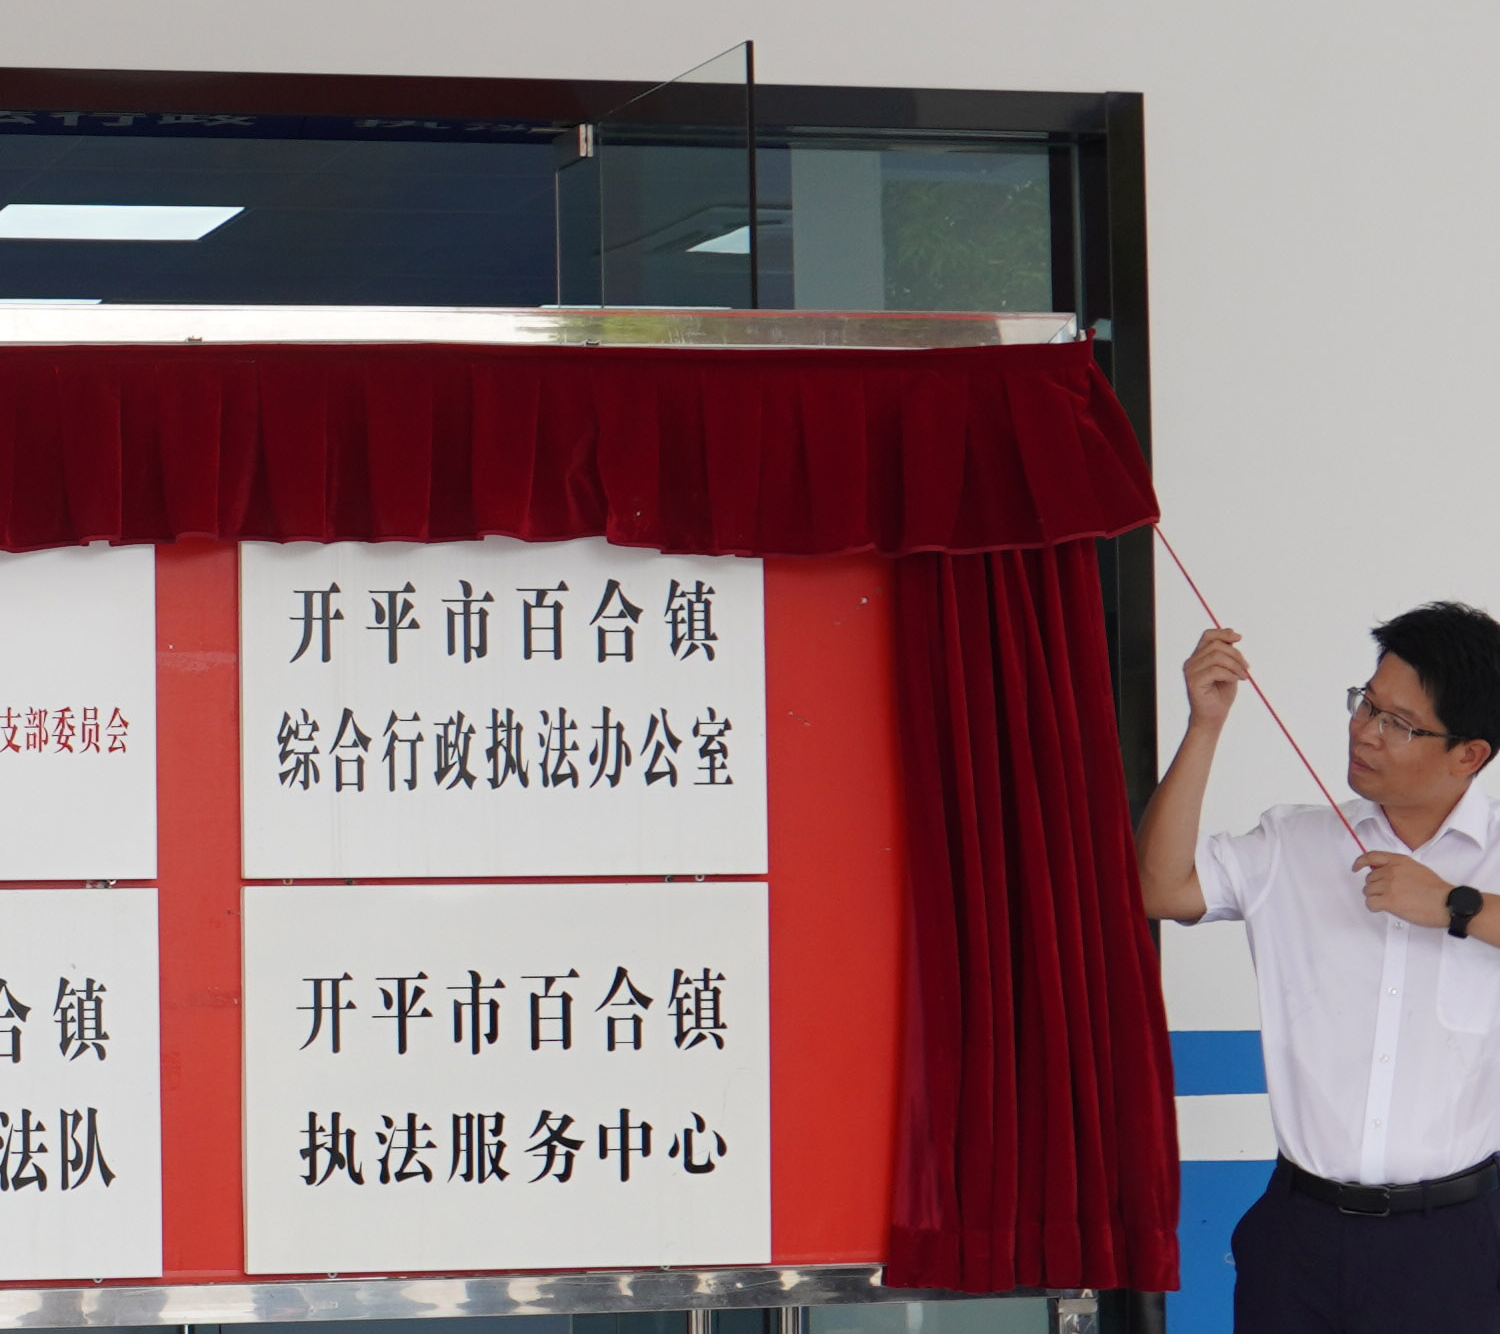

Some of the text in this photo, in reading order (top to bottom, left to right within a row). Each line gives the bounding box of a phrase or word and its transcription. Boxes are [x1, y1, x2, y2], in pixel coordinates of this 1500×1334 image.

[290, 579, 720, 666] 开平市百合镇
[277, 706, 735, 794] 综合行政执法办公室
[296, 966, 729, 1057] 开平市百合镇
[299, 1108, 729, 1188] 执法服务中心
